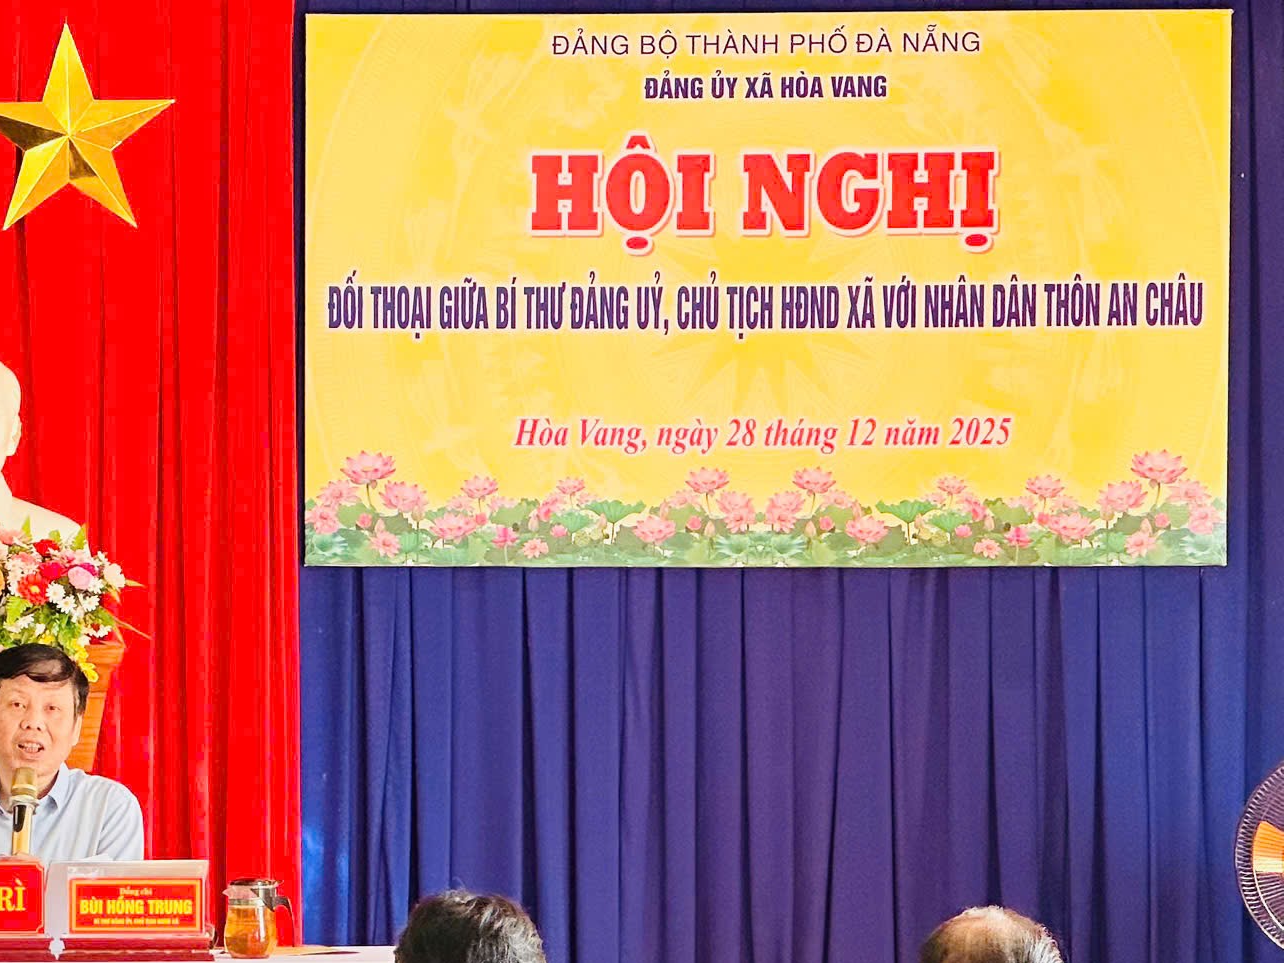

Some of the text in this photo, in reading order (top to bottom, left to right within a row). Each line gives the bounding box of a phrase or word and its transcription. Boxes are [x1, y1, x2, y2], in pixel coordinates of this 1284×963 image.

[551, 23, 981, 61] ĐẢNG BỘ THÀNH PHỐ ĐÀ NẴNG
[644, 69, 887, 99] ĐẢNG ỦY XÃ HÒA VANG
[530, 134, 996, 251] HỘI NGHỊ
[327, 270, 1204, 340] ĐỐI THOẠI GIỮA BÍ THƯ ĐẢNG UỶ, CHỦ TỊCH HĐND XÃ VỚI NHÂN DÂN THÔN AN CHÂU
[514, 417, 1012, 454] Hòa Vang, ngày 28 tháng 12 năm 2025
[147, 899, 193, 915] TRUNG
